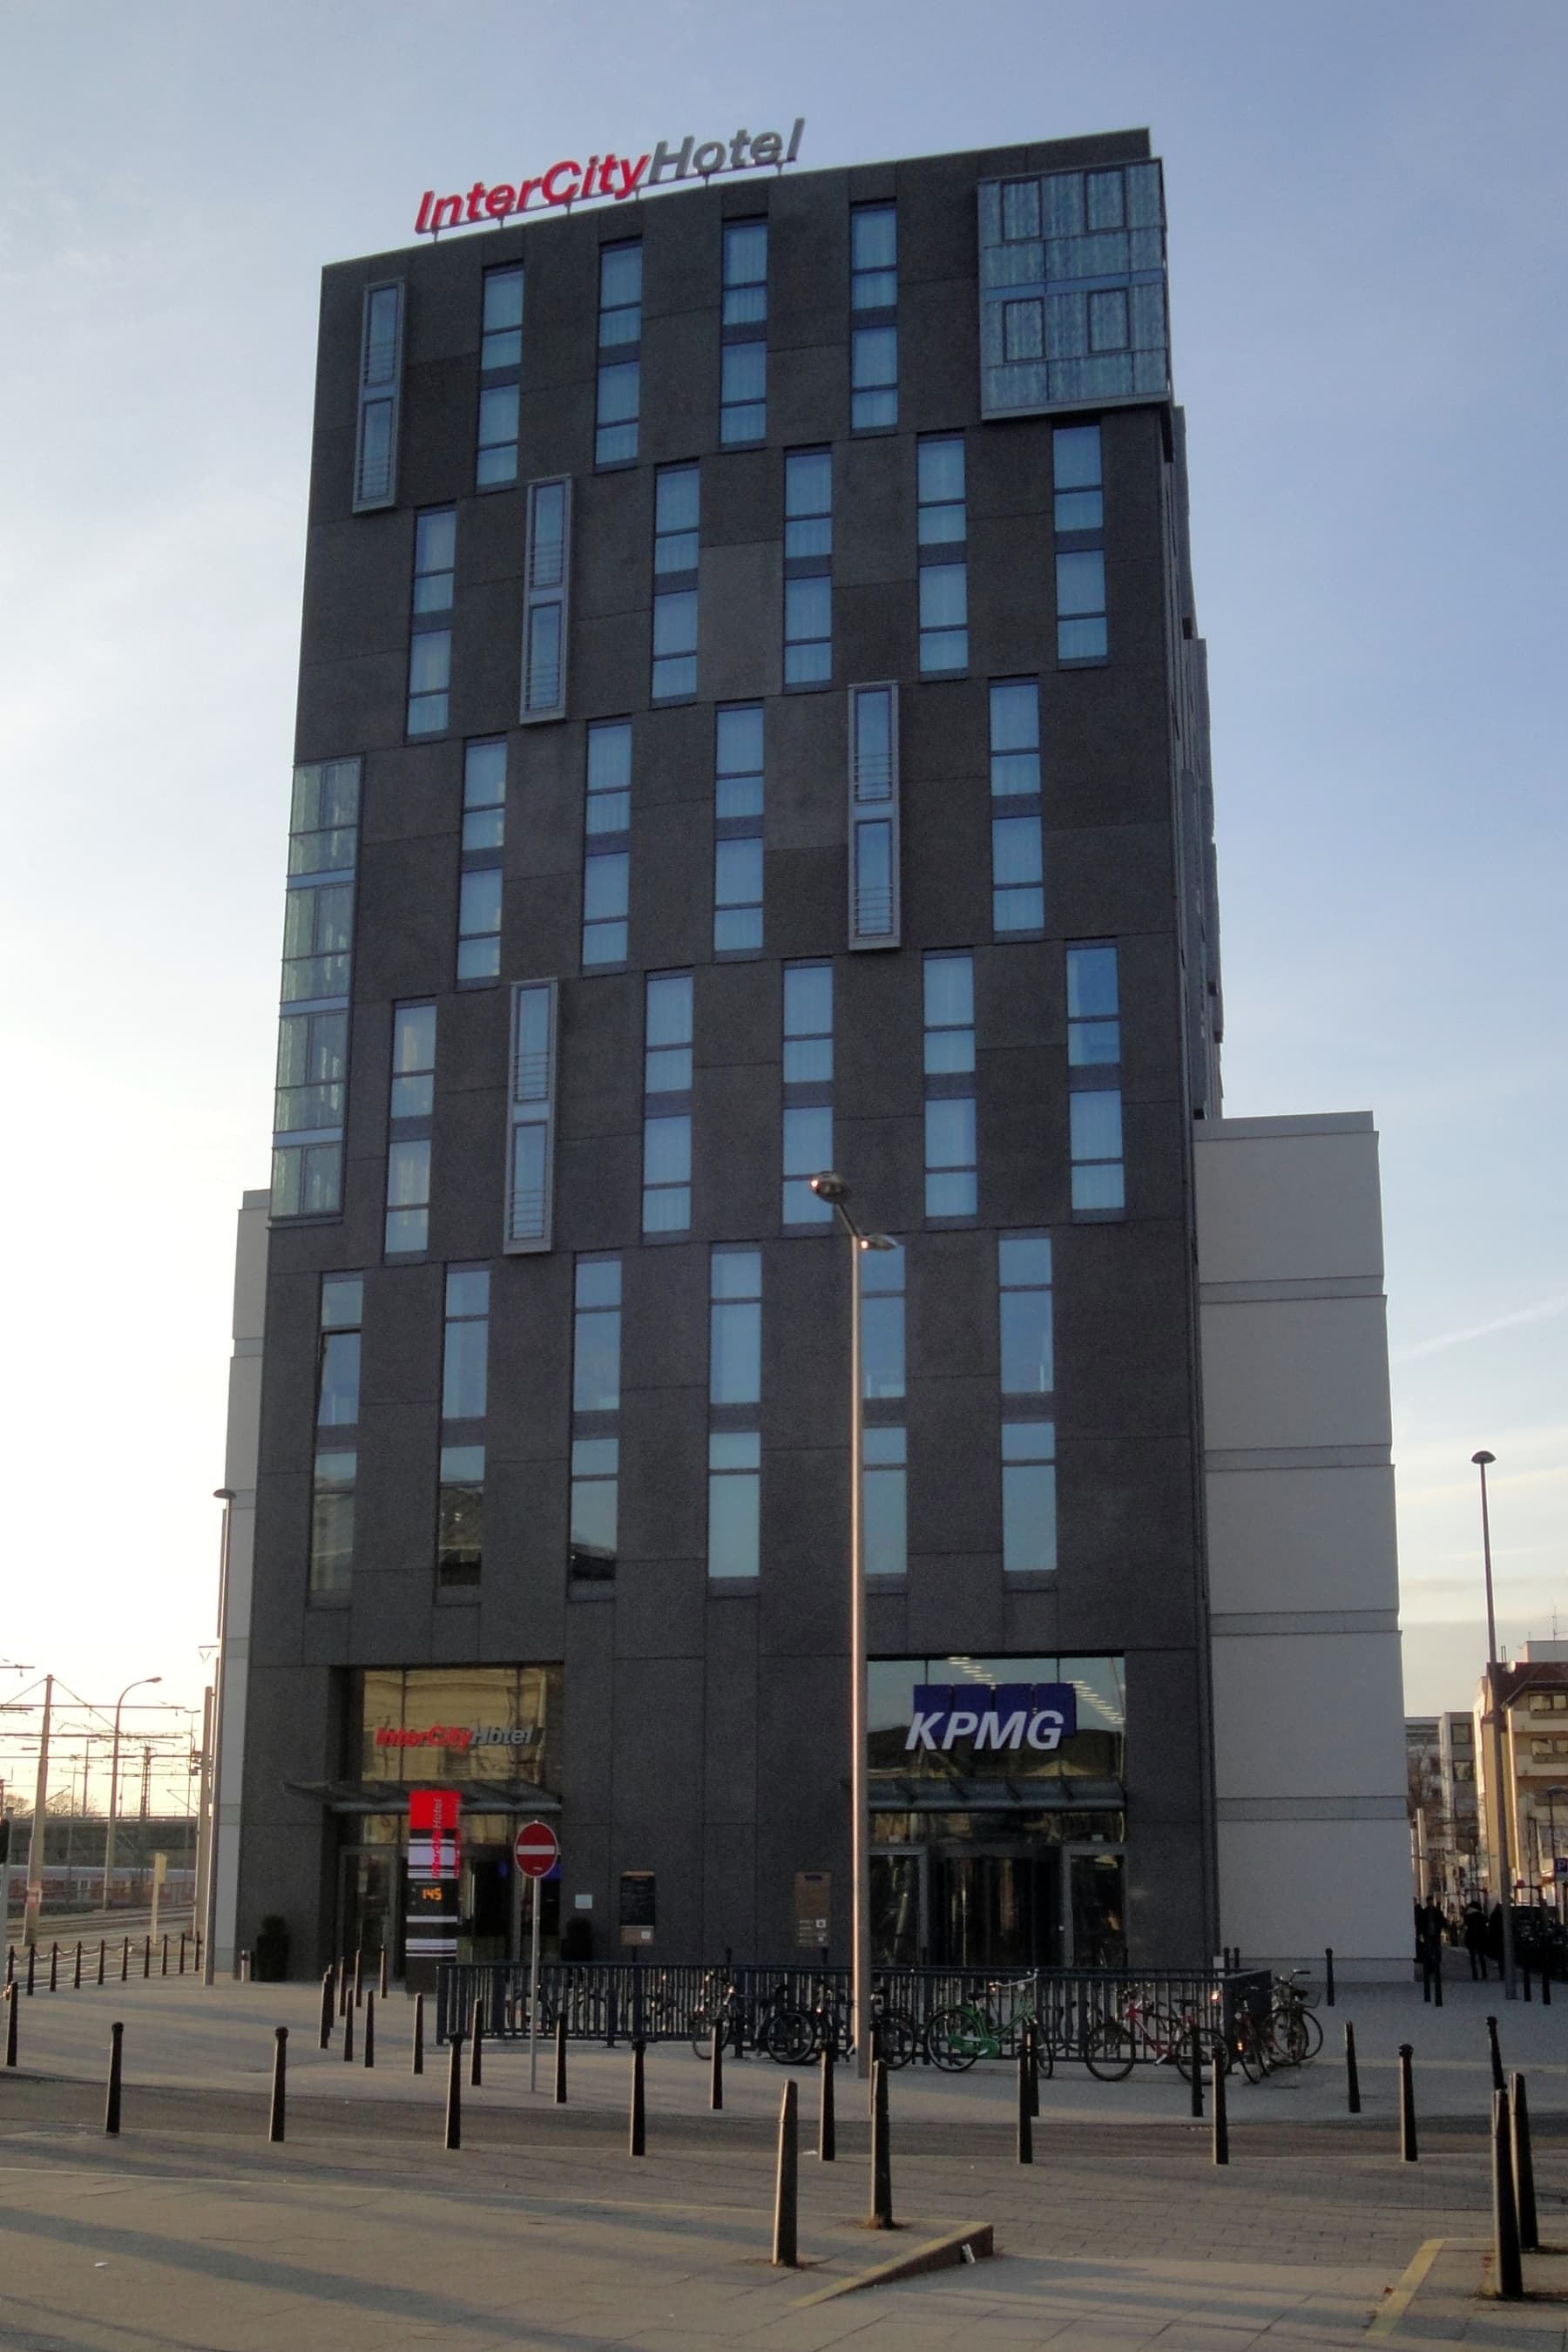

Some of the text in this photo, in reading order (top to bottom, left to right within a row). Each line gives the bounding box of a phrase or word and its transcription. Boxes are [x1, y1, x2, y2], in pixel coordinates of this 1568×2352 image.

[415, 118, 805, 233] InterCityHotel
[377, 1725, 533, 1750] InterCityHotel
[904, 1710, 1064, 1750] KPMG
